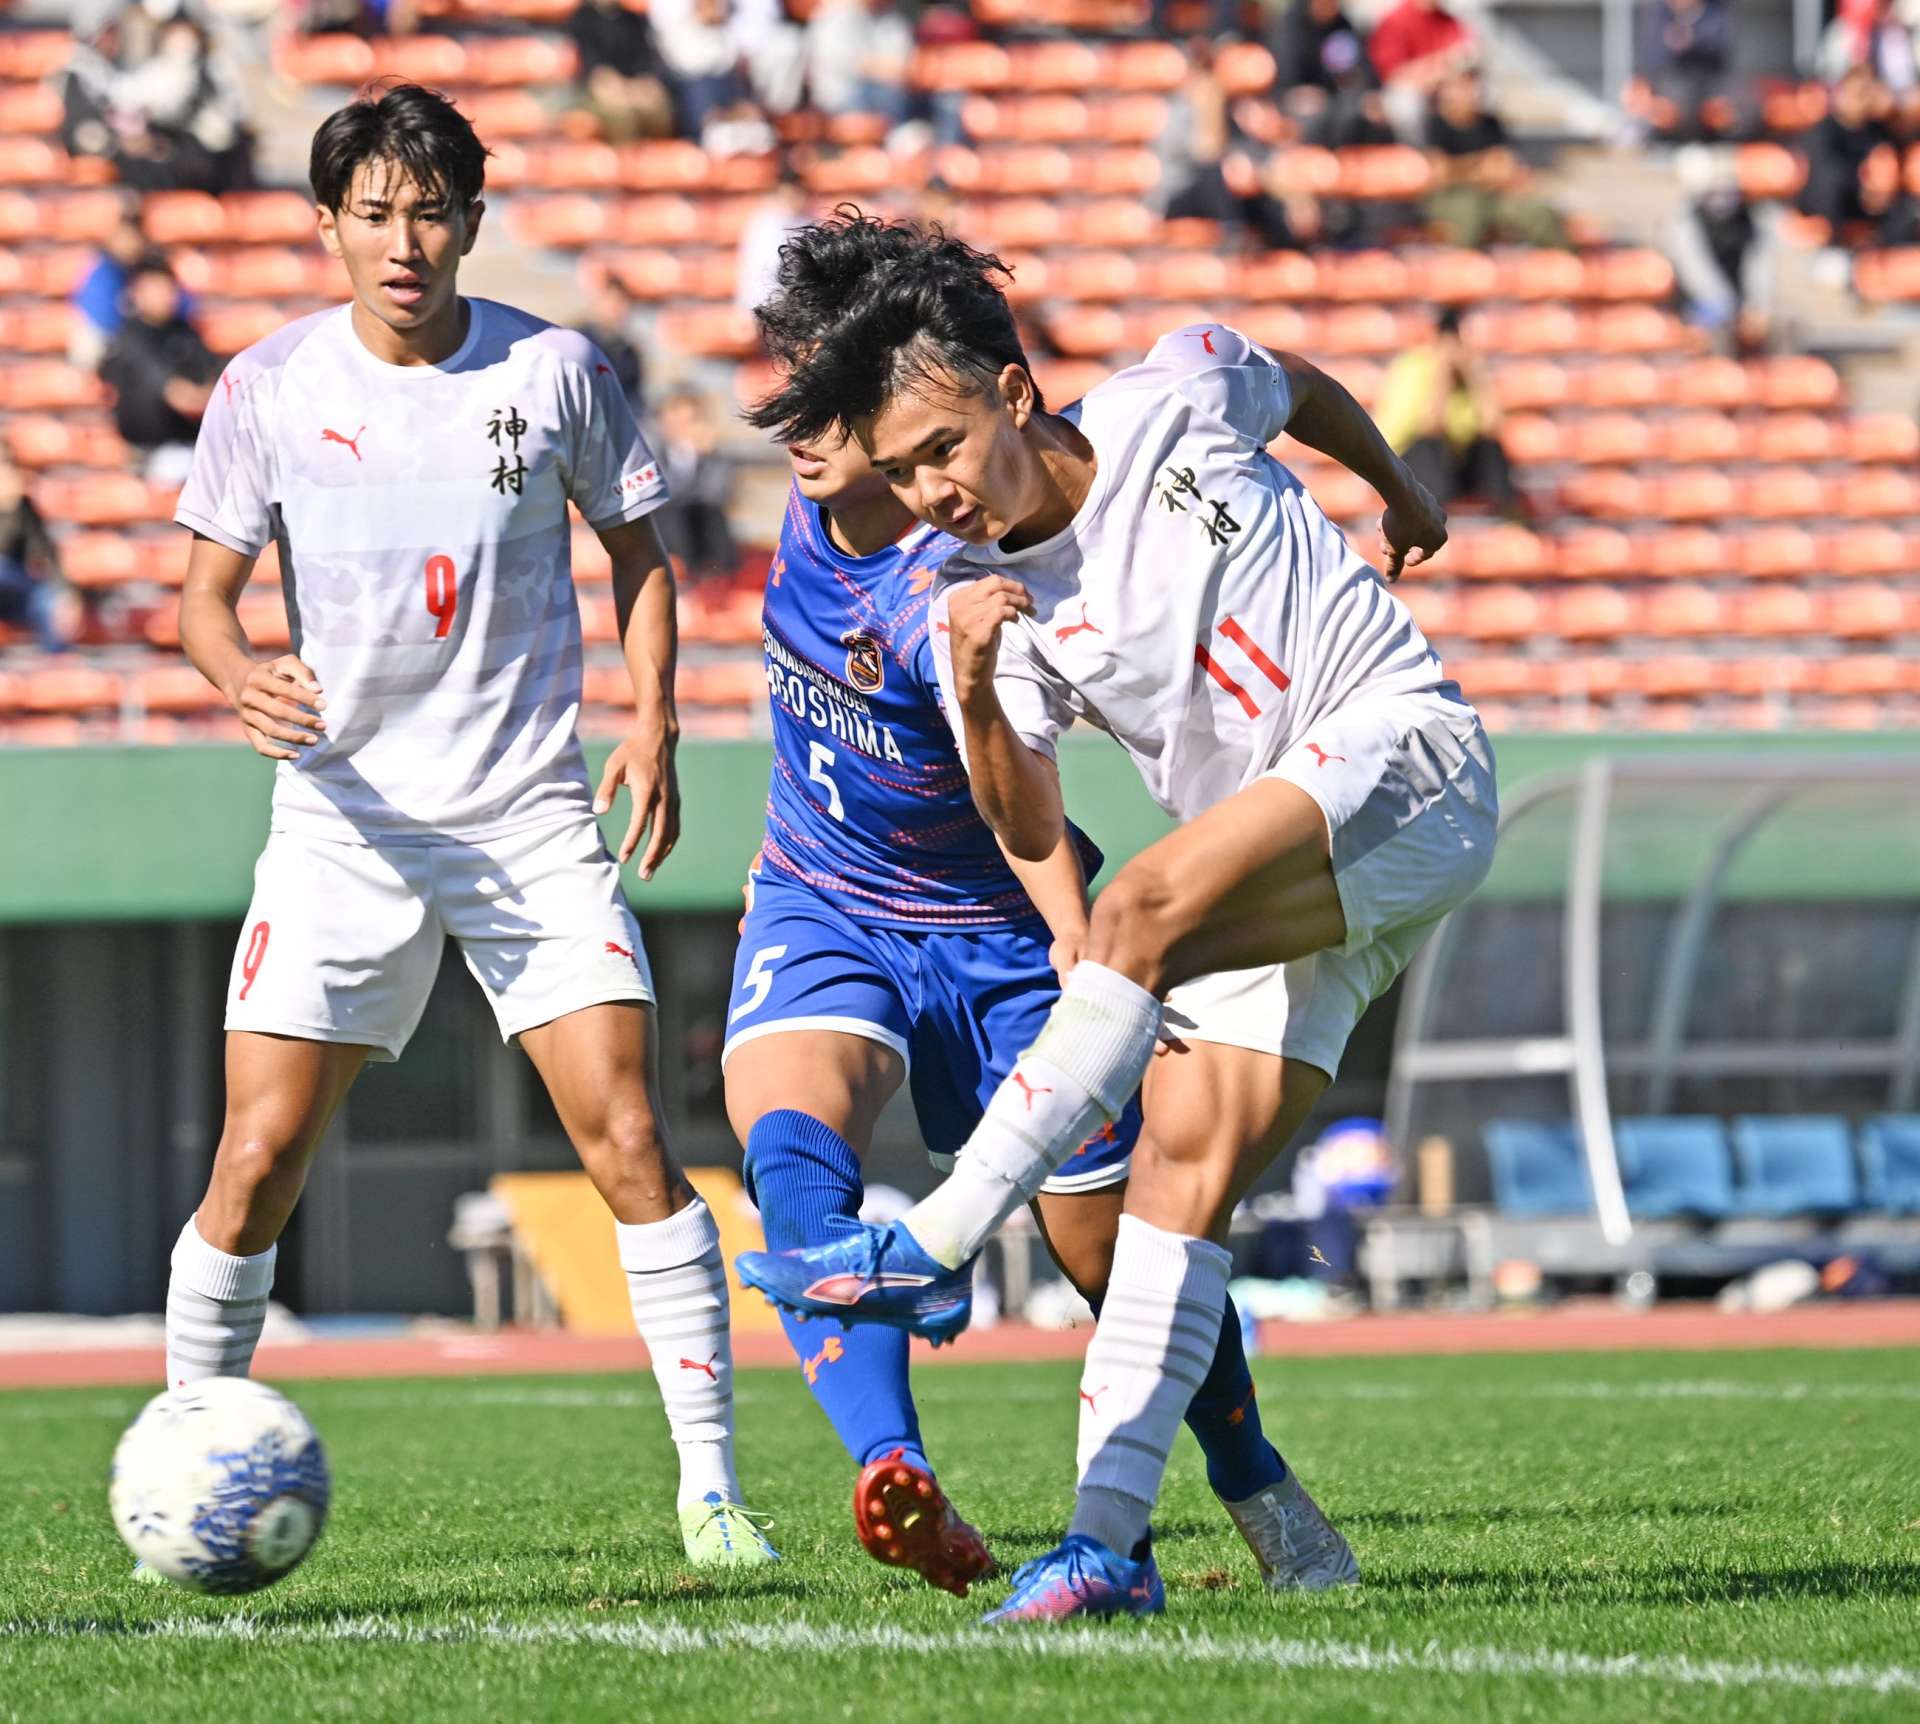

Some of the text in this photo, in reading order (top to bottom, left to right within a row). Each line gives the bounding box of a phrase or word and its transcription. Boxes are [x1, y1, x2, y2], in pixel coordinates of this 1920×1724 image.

[485, 406, 529, 496] 神村
[1156, 466, 1241, 546] 神村
[424, 554, 457, 638] 9
[1194, 615, 1291, 720] 11
[808, 740, 845, 822] 5
[239, 921, 270, 1001] 9
[730, 944, 788, 1025] 5
